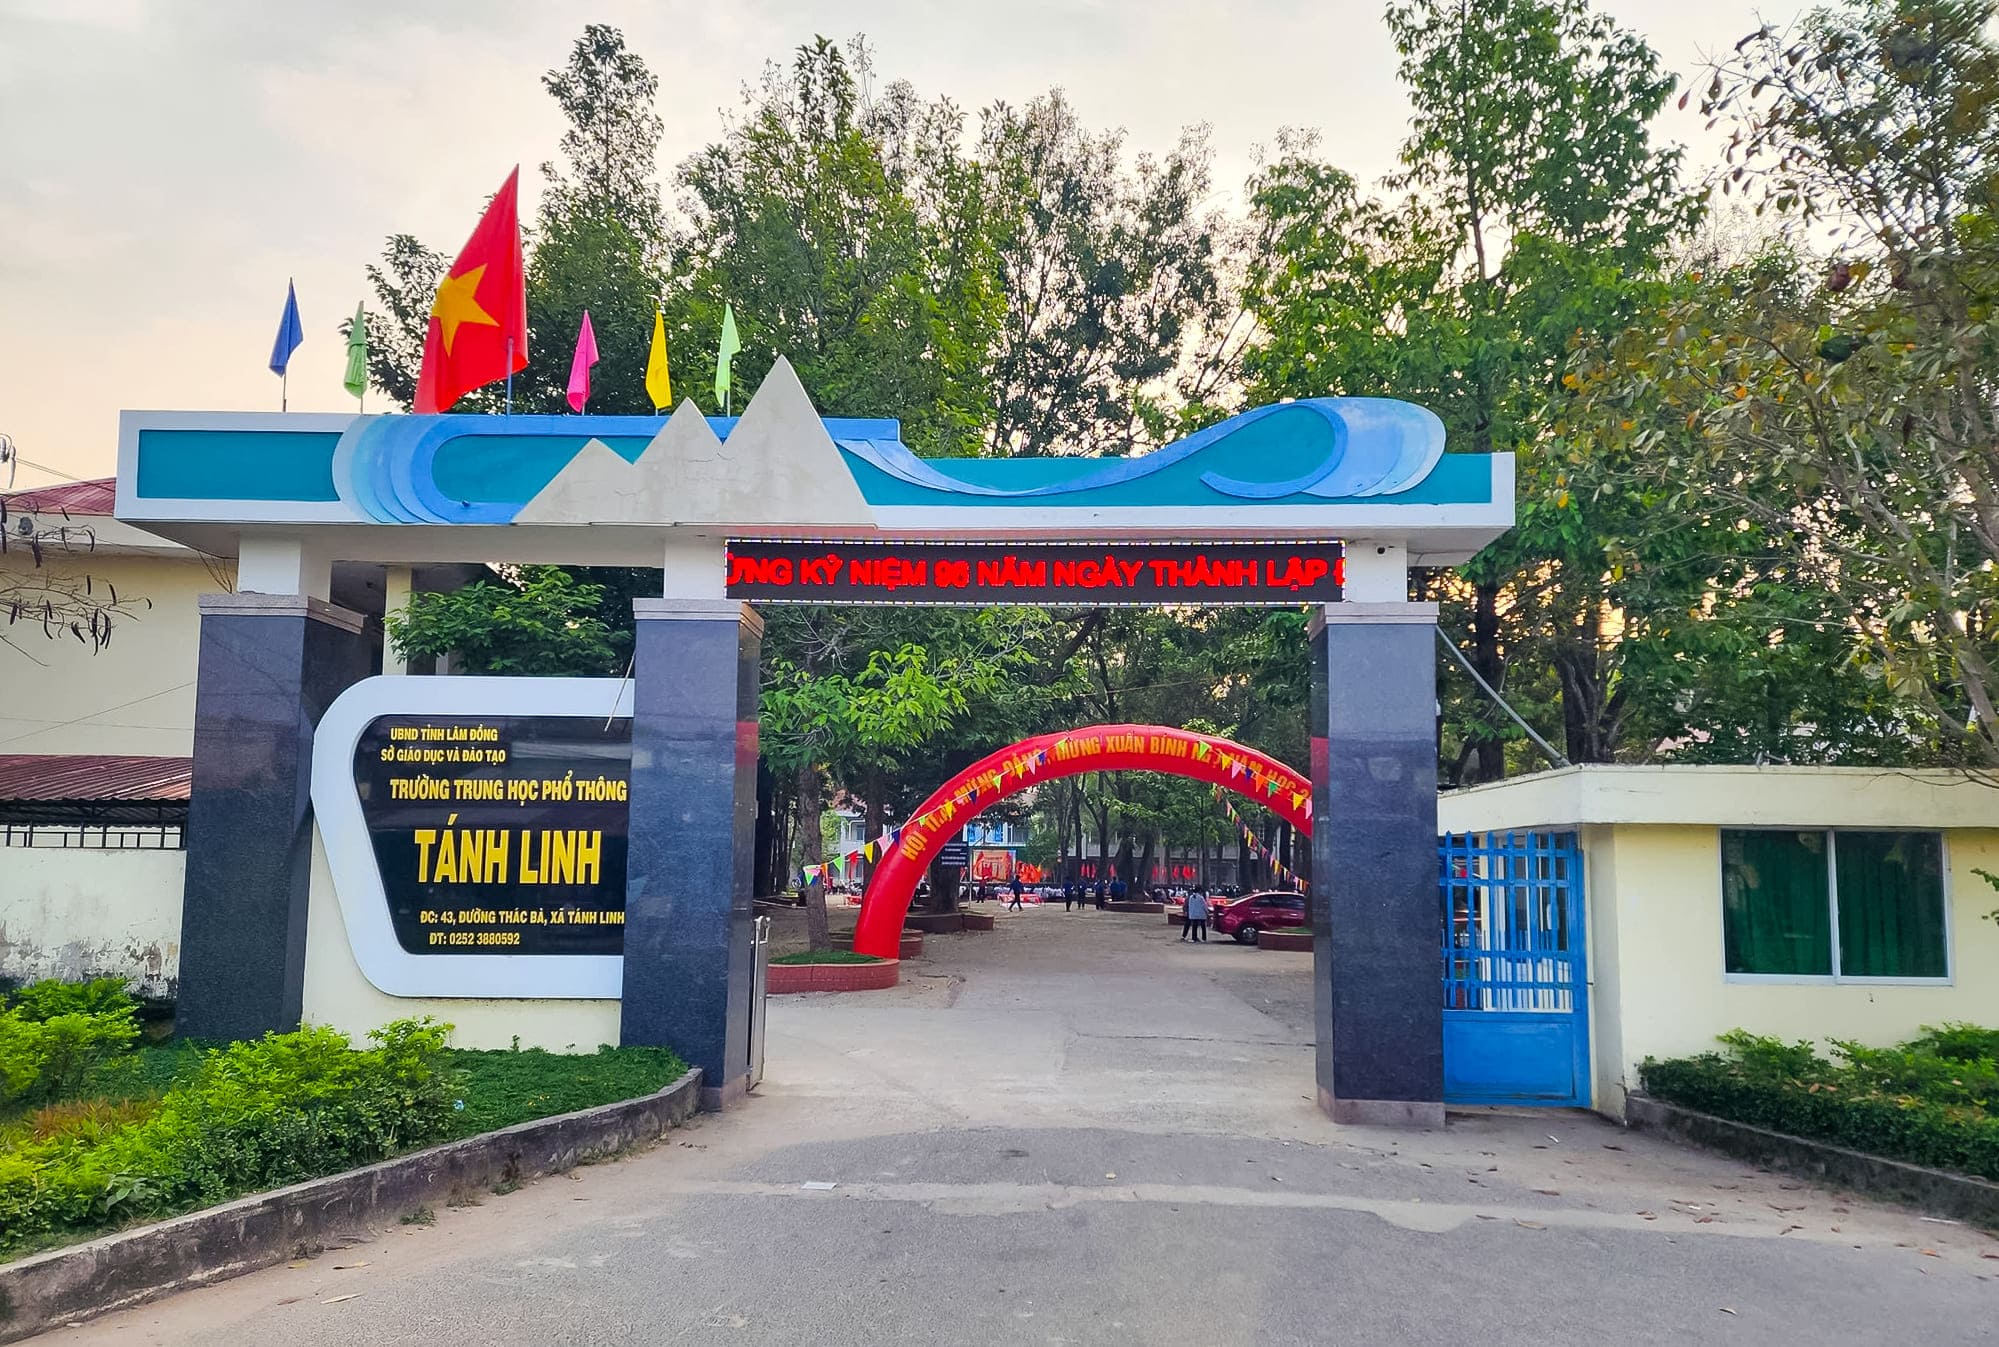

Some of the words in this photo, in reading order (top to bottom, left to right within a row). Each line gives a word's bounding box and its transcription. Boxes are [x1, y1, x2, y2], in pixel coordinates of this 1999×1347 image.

[849, 556, 927, 591] NIỆM
[977, 556, 1046, 587] NĂM
[1054, 555, 1143, 588] NGÀY
[1148, 555, 1258, 587] THÀNH
[1266, 556, 1329, 591] LẬP
[390, 727, 418, 741] UBND
[421, 724, 445, 741] TỈNH
[446, 726, 467, 741] LÂM
[470, 724, 498, 742] ĐỒNG
[380, 745, 395, 762] SỞ
[397, 747, 422, 762] GIÁO
[424, 749, 445, 765] DỤC
[446, 747, 461, 762] VÀ
[462, 747, 484, 762] ĐÀO
[486, 750, 506, 766] TẠO
[390, 774, 450, 800] TRƯỜNG
[454, 779, 504, 801] TRUNG
[508, 780, 538, 806] HỌC
[542, 770, 573, 801] PHỔ
[576, 776, 627, 802] THÔNG
[901, 830, 928, 861] HỘI
[1106, 732, 1145, 753] XUÂN
[1150, 734, 1187, 758] BÍNH
[414, 813, 510, 884] TÁNH
[519, 830, 602, 885] LINH
[420, 910, 438, 924] ĐC:
[440, 911, 456, 926] 43,
[458, 907, 496, 924] ĐƯỜNG
[499, 908, 527, 924] THÁC
[550, 908, 565, 924] XÃ
[568, 908, 597, 924] TÁNH
[600, 911, 625, 924] LINH
[429, 932, 447, 945] ĐT:
[450, 932, 474, 945] 0252
[476, 932, 520, 945] 3880592
